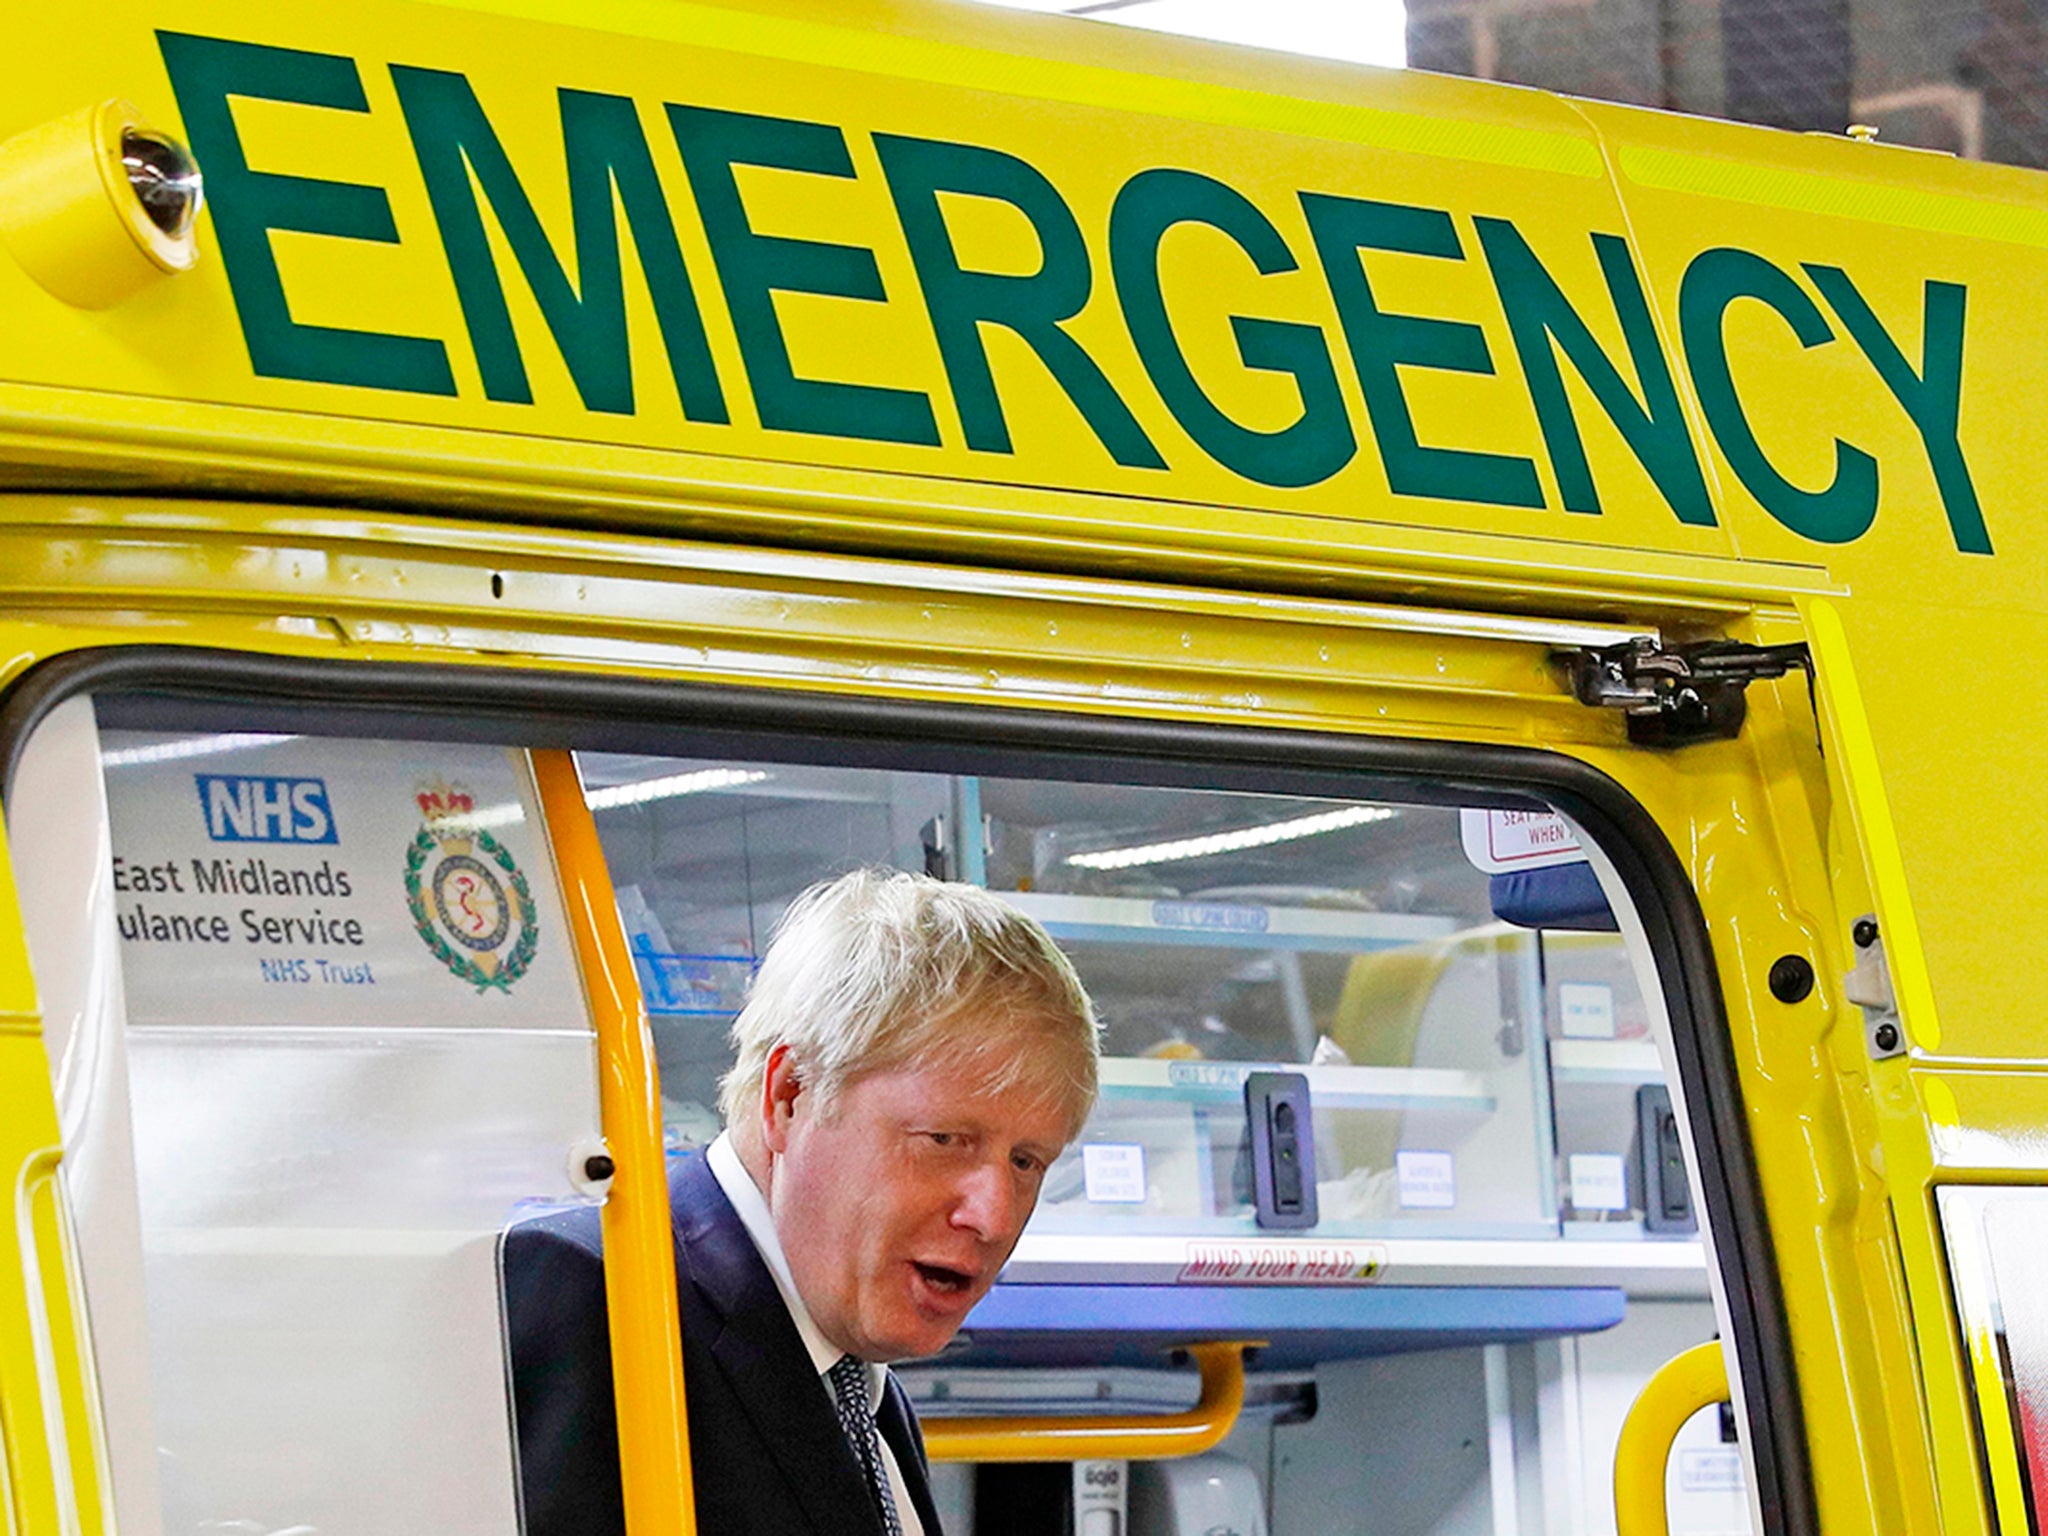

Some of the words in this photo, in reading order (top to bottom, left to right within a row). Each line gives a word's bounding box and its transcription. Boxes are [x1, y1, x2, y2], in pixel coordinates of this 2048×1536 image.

[154, 29, 1995, 556] EMERGENCY
[206, 778, 328, 840] NHS
[1529, 824, 1565, 845] WHEN
[112, 857, 184, 893] East
[192, 859, 352, 898] Midlands
[117, 904, 230, 943] ulance
[240, 909, 365, 946] Service
[259, 959, 311, 984] NHS
[315, 959, 376, 985] Trust
[1187, 1249, 1242, 1278] MIND
[1245, 1249, 1299, 1278] YOUR
[1301, 1249, 1355, 1278] HEAD
